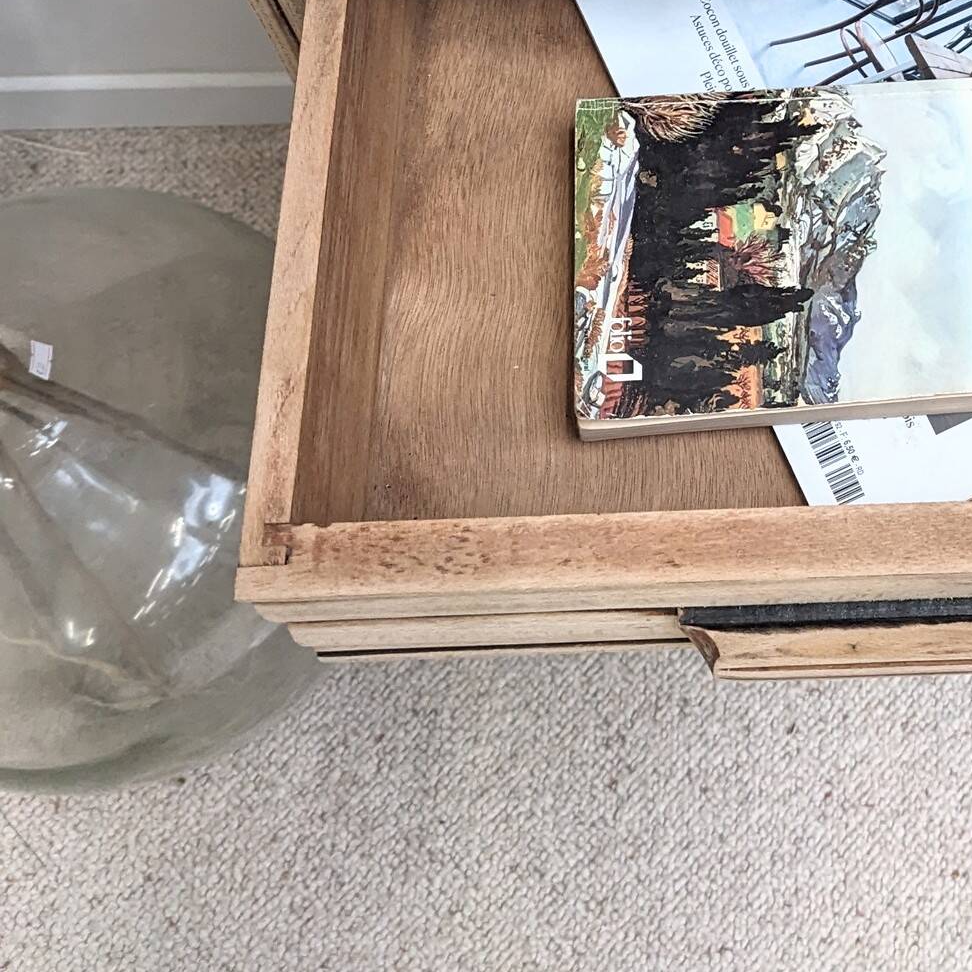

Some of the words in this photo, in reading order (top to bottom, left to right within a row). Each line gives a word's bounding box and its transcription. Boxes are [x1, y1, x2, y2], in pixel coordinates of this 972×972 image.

[690, 15, 714, 52] Astuces
[709, 53, 726, 77] déco
[716, 28, 739, 65] douillet
[733, 65, 750, 88] sous
[610, 315, 633, 353] folio
